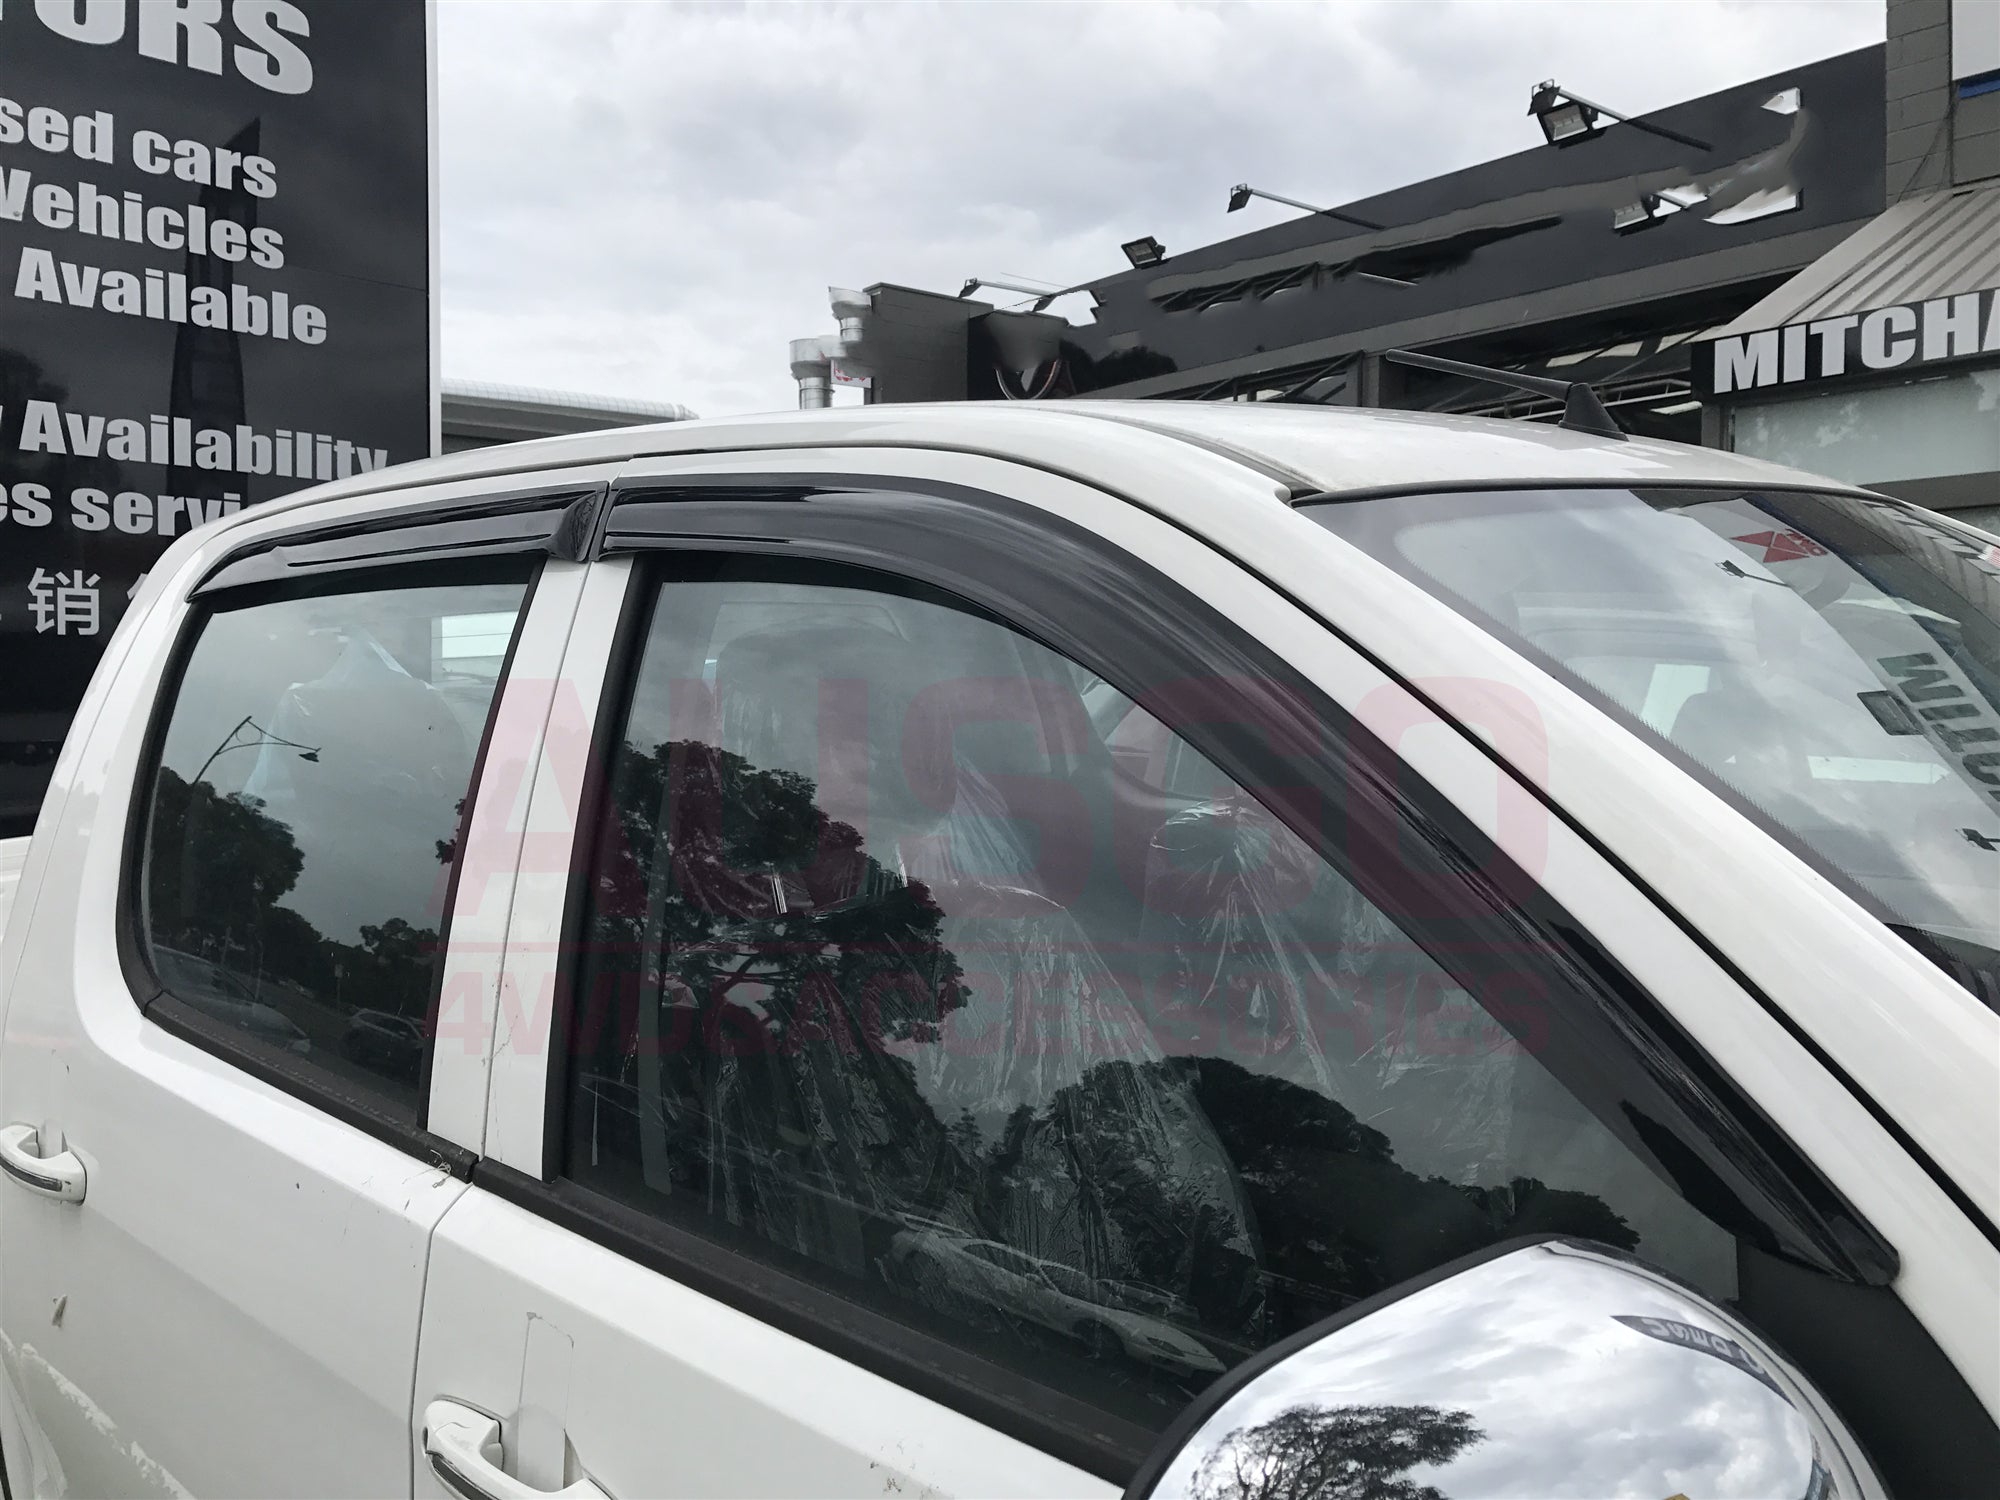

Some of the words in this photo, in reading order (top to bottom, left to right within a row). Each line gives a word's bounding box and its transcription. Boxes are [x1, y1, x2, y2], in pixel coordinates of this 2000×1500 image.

[0, 0, 313, 95] RS
[132, 129, 278, 199] cars
[0, 166, 285, 270] Vehicles
[14, 247, 327, 345] Available
[0, 481, 52, 527] s
[27, 566, 149, 636] 销
